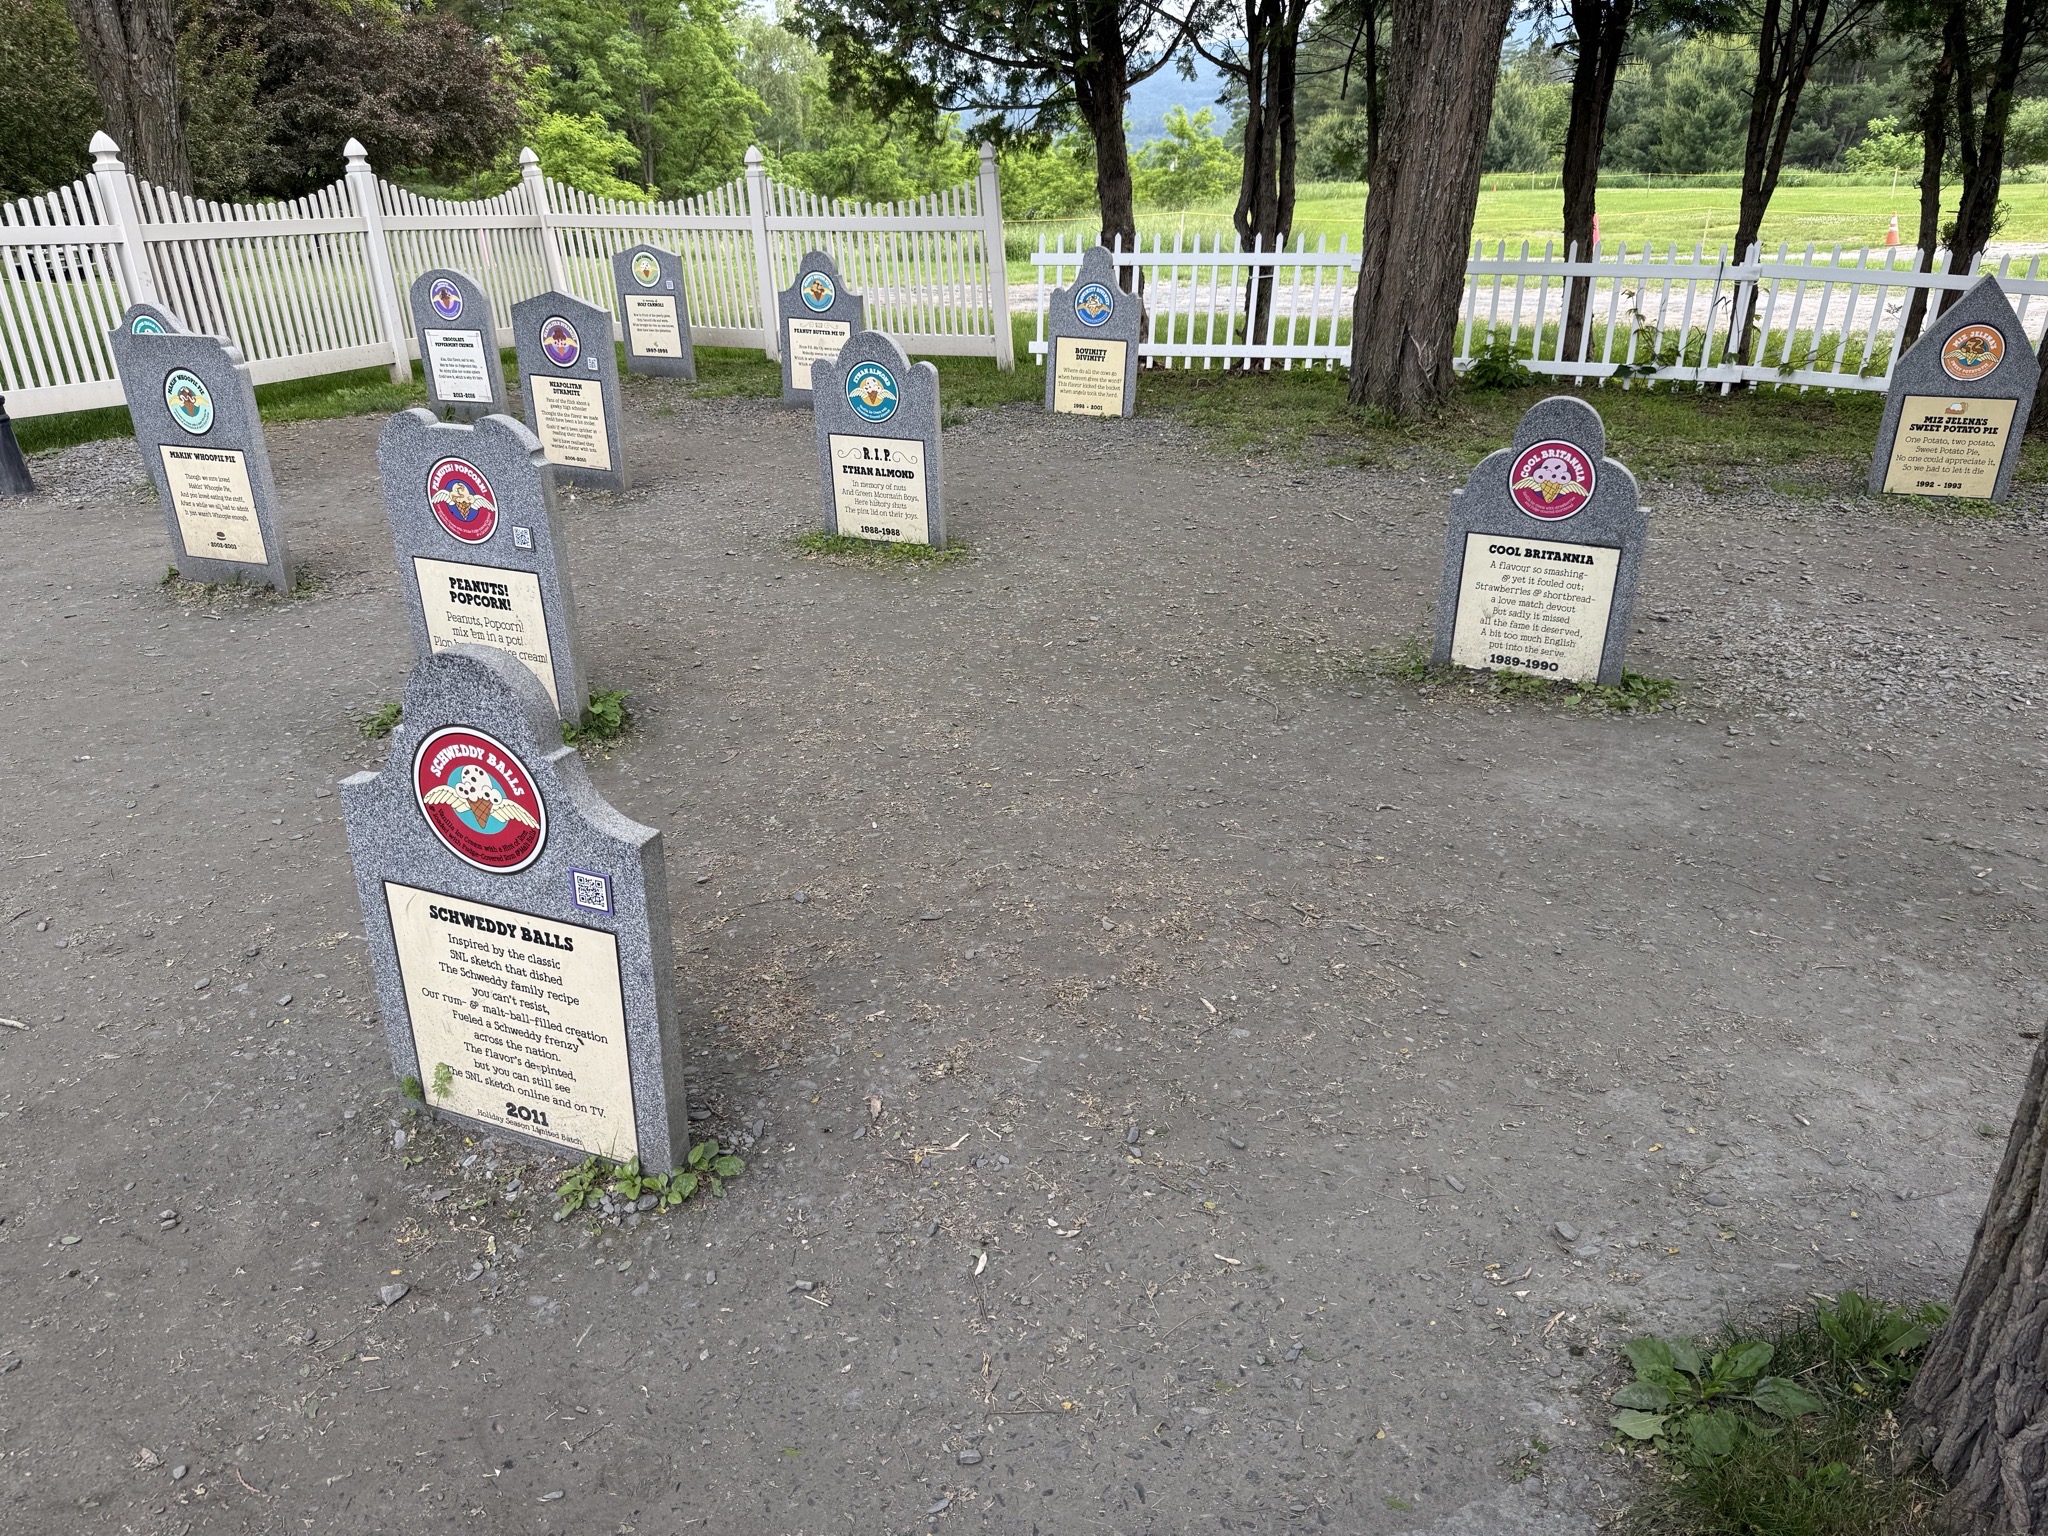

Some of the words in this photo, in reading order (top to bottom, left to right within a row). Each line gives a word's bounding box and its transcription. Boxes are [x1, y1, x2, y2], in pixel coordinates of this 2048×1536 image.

[1953, 334, 1967, 348] MIZ
[1075, 347, 1107, 356] BOVINITY
[1076, 354, 1105, 362] DIVINITY
[1950, 360, 1961, 371] SWEET
[549, 381, 582, 389] NEAPOLITAN
[853, 368, 868, 384] ETHAN
[869, 368, 890, 386] ALMOND
[552, 388, 580, 396] DYNAMITE
[1909, 423, 1942, 432] SWEET
[1943, 425, 1981, 434] POTATO
[1982, 426, 1999, 434] PIE
[1923, 416, 1944, 424] MIZ
[1945, 416, 1988, 426] JELENA'S
[1904, 435, 1921, 443] One
[1922, 436, 1949, 445] Potato,
[169, 450, 192, 459] MAKIN'
[193, 452, 224, 462] WHOOPIE
[224, 455, 236, 463] PIE
[1915, 445, 1938, 454] Sweet
[1939, 446, 1965, 455] Potato
[1966, 448, 1980, 456] Pie,
[1520, 455, 1541, 477] COOL
[1541, 449, 1585, 482] BRITANNIA
[1944, 457, 1986, 465] appreciate
[1987, 458, 1996, 466] it,
[432, 464, 454, 491] PEANUTS!
[454, 464, 487, 493] POPCORN!
[842, 465, 873, 476] ETHAN
[875, 468, 914, 479] ALMOND
[860, 482, 884, 490] memory
[854, 489, 873, 497] Green
[873, 491, 902, 500] Mountain
[903, 493, 919, 502] Boys,
[854, 497, 868, 506] Here
[869, 499, 891, 509] history
[891, 501, 907, 509] shuts
[844, 505, 856, 513] The
[856, 507, 870, 515] pint
[904, 512, 918, 520] joys.
[860, 525, 900, 536] 1988-1988
[1488, 544, 1521, 557] COOL
[1524, 548, 1594, 565] BRITANNIA
[1489, 560, 1496, 568] A
[1498, 561, 1531, 573] flavour
[449, 577, 508, 596] PEANUTS!
[1475, 581, 1531, 596] Strawberries
[1511, 576, 1526, 584] yet
[1528, 576, 1535, 585] it
[1536, 577, 1564, 588] fouled
[1565, 582, 1584, 591] out;
[449, 590, 511, 610] POPCORN!
[1497, 595, 1516, 606] love
[1518, 600, 1544, 609] match
[1545, 602, 1576, 613] devout
[446, 610, 483, 628] Peanuts,
[483, 616, 524, 632] Popcorn!
[1492, 606, 1507, 616] But
[1508, 609, 1531, 620] sadly
[1533, 612, 1540, 620] it
[1542, 614, 1570, 624] missed
[452, 626, 469, 637] mix
[486, 630, 497, 642] in
[498, 634, 504, 643] a
[505, 635, 524, 646] pot!
[1493, 618, 1508, 627] the
[1509, 620, 1530, 630] fame
[1532, 623, 1539, 632] it
[1540, 624, 1582, 638] deserved,
[1480, 627, 1487, 636] A
[1488, 628, 1501, 638] bit
[1503, 631, 1518, 640] too
[1520, 634, 1542, 643] much
[1544, 636, 1576, 648] English
[518, 651, 548, 663] cream!
[1488, 641, 1503, 649] put
[1505, 642, 1523, 652] into
[1524, 645, 1539, 654] the
[1540, 648, 1566, 658] serve.
[1490, 654, 1558, 672] 1989-1990
[430, 744, 485, 778] SCHWEDDY
[486, 753, 525, 796] BALLS
[429, 905, 516, 938] SCHWEDDY
[520, 926, 573, 951] BALLS
[447, 933, 490, 952] Inspired
[491, 943, 505, 958] by
[507, 948, 525, 961] the
[527, 953, 560, 970] classic
[449, 949, 468, 962] SNL
[470, 955, 502, 971] sketch
[504, 963, 527, 977] that
[529, 969, 563, 986] dished
[438, 961, 458, 975] The
[460, 967, 508, 989] Schweddy
[510, 980, 544, 998] family
[547, 991, 579, 1006] recipe
[471, 987, 490, 998] you
[492, 992, 517, 1005] can't
[519, 999, 550, 1015] resist,
[421, 987, 440, 999] Our
[482, 1005, 562, 1032] malt-ball-filled
[565, 1026, 608, 1044] creation
[452, 1009, 483, 1026] Fueled
[494, 1021, 541, 1043] Schweddy
[544, 1034, 579, 1053] frenzy
[463, 1041, 482, 1055] The
[485, 1047, 522, 1066] flavor's
[464, 1070, 483, 1083] SNL
[484, 1076, 515, 1092] sketch
[517, 1087, 550, 1102] online
[552, 1097, 572, 1108] and
[573, 1103, 588, 1113] on
[589, 1105, 606, 1118] TV.
[506, 1102, 549, 1127] 2011
